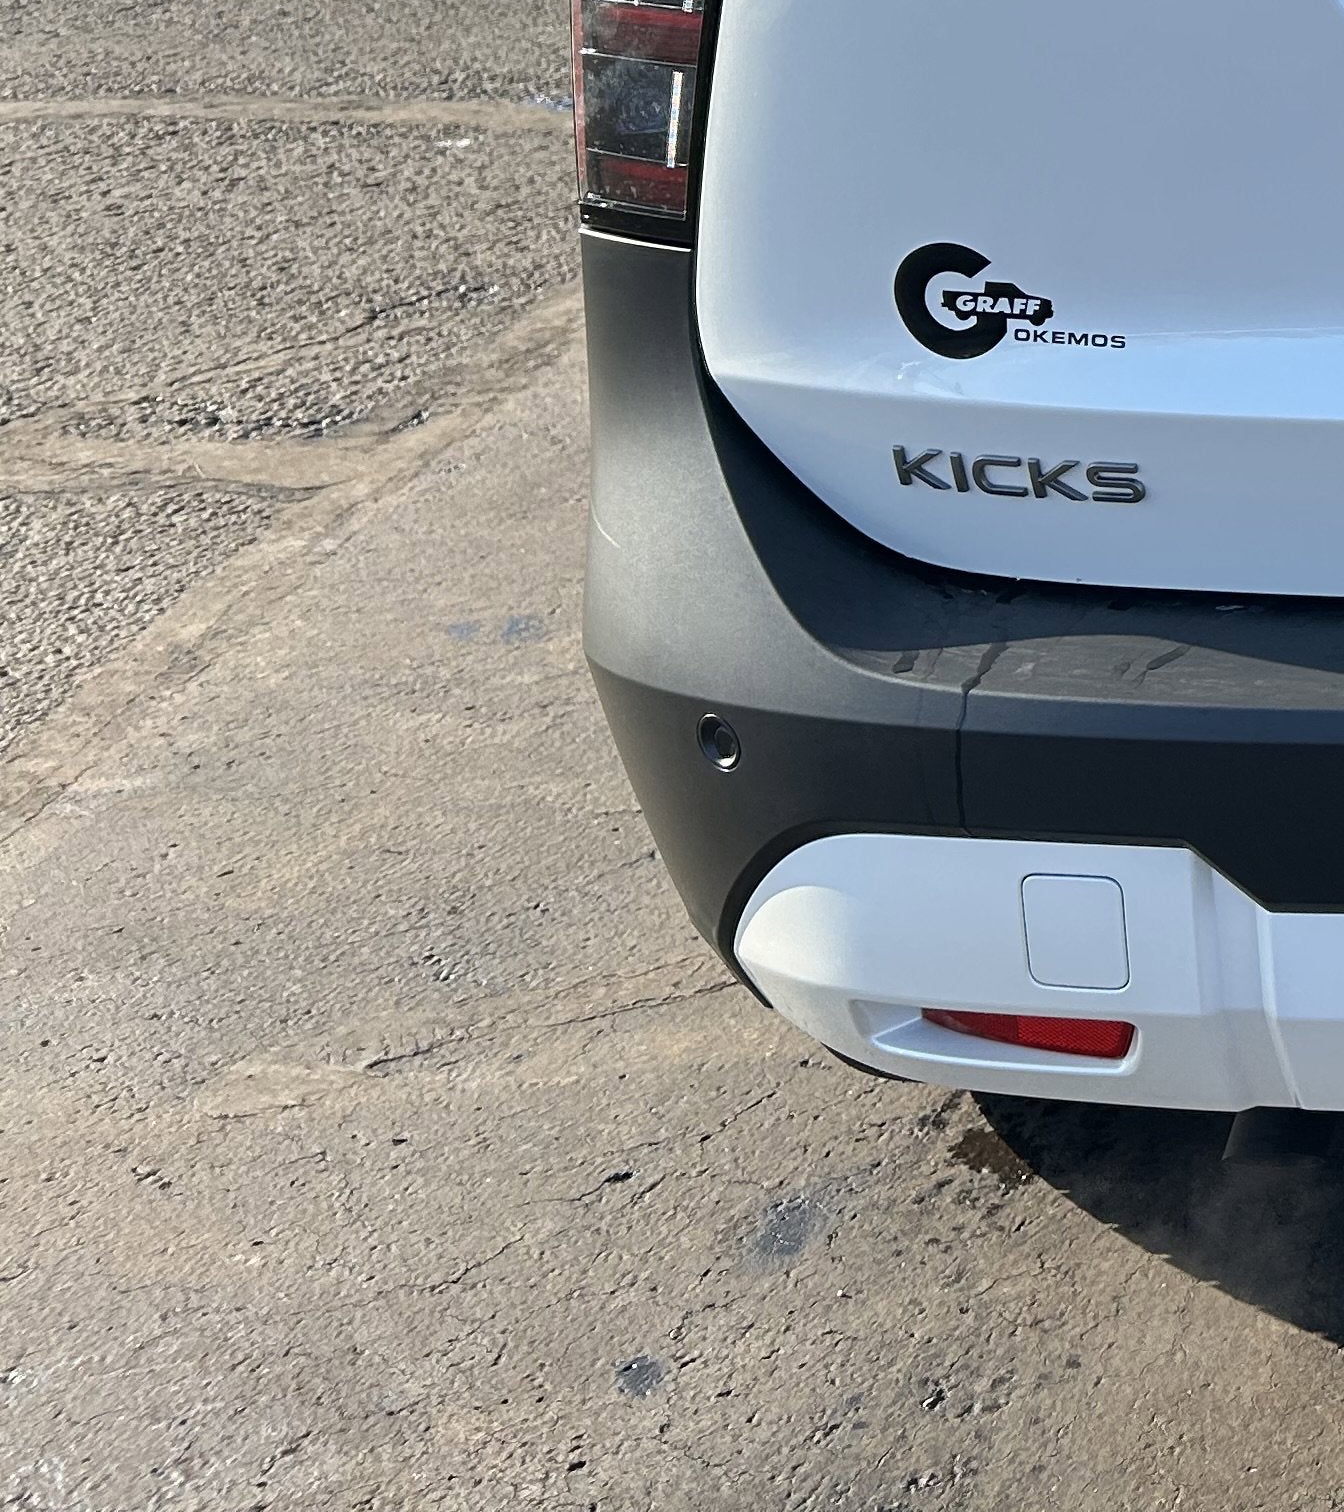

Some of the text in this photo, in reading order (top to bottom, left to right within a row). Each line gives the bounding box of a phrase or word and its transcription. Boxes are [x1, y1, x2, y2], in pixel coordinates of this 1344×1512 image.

[955, 295, 1041, 316] GRAFF
[1014, 328, 1126, 349] OKEMOS
[892, 444, 1147, 504] KICKS
